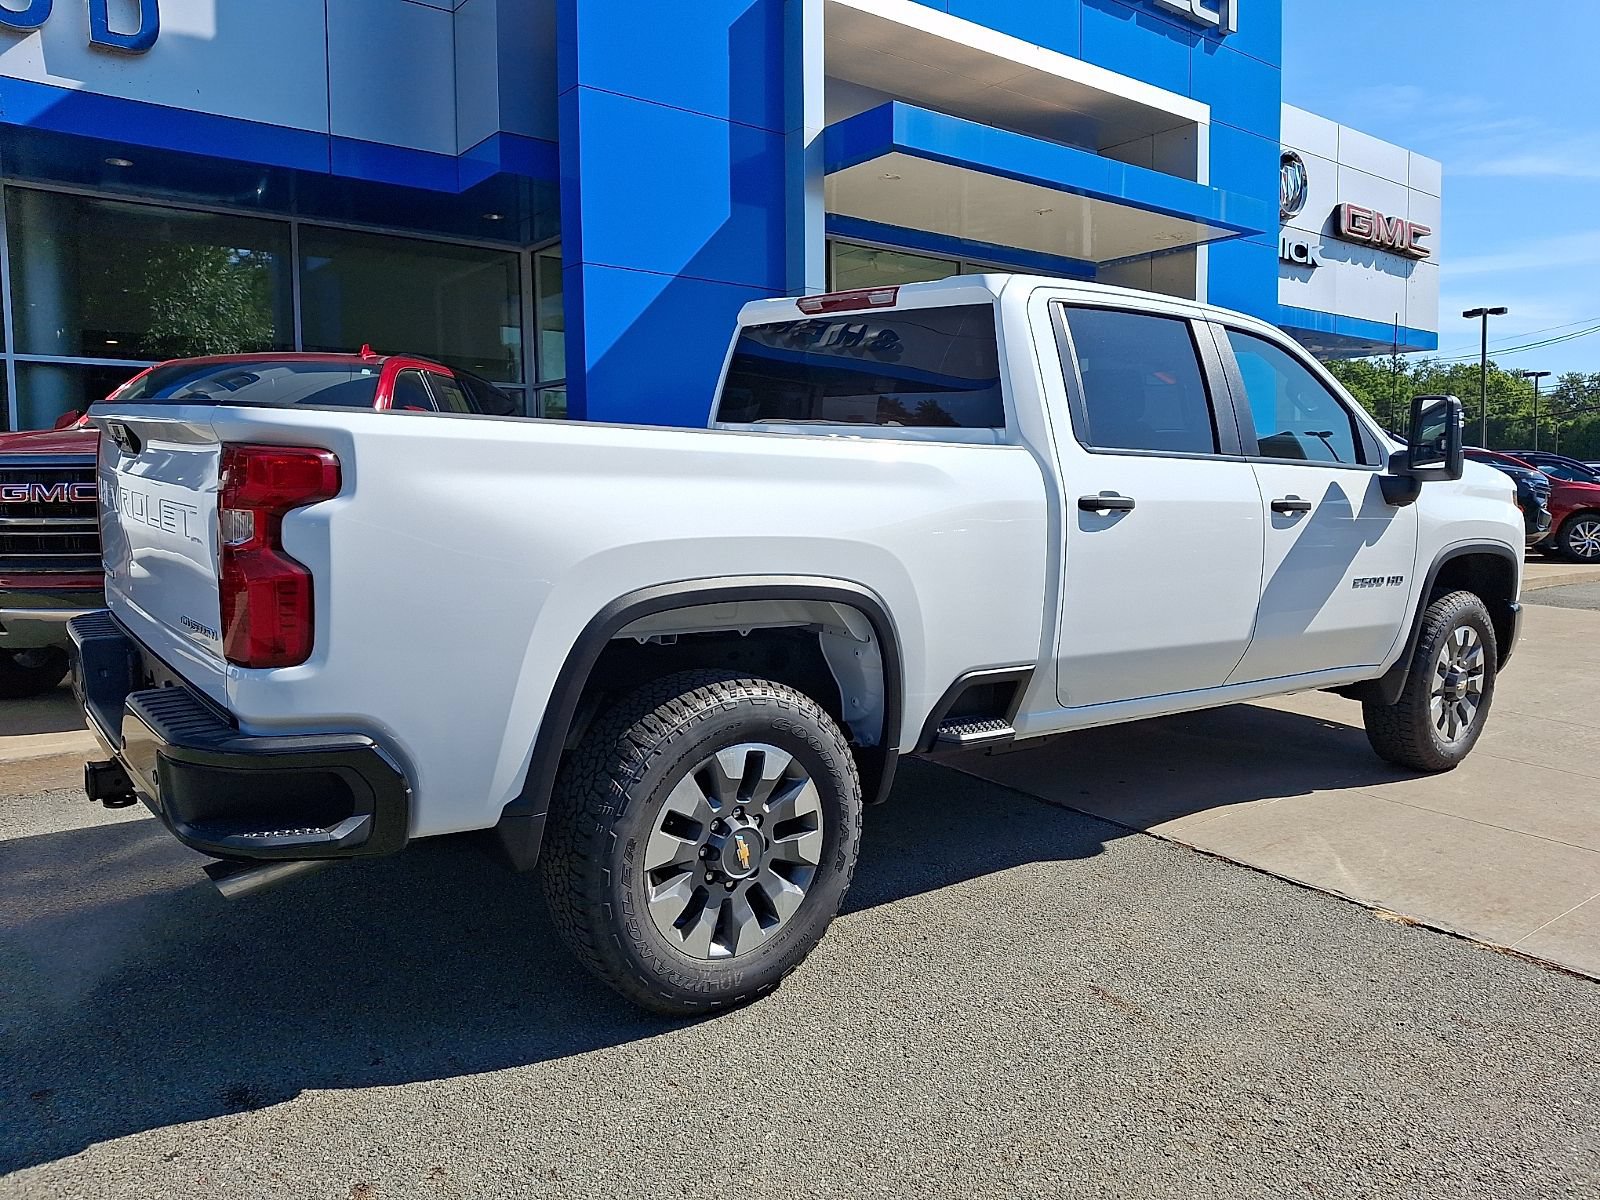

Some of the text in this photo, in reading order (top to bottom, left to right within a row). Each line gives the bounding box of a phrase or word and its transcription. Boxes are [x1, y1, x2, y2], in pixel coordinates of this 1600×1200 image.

[1279, 237, 1324, 267] ICK
[1341, 202, 1432, 257] GMC
[0, 483, 97, 502] GMC
[771, 717, 850, 873] GOODYEAR
[621, 836, 711, 993] WRANGLER
